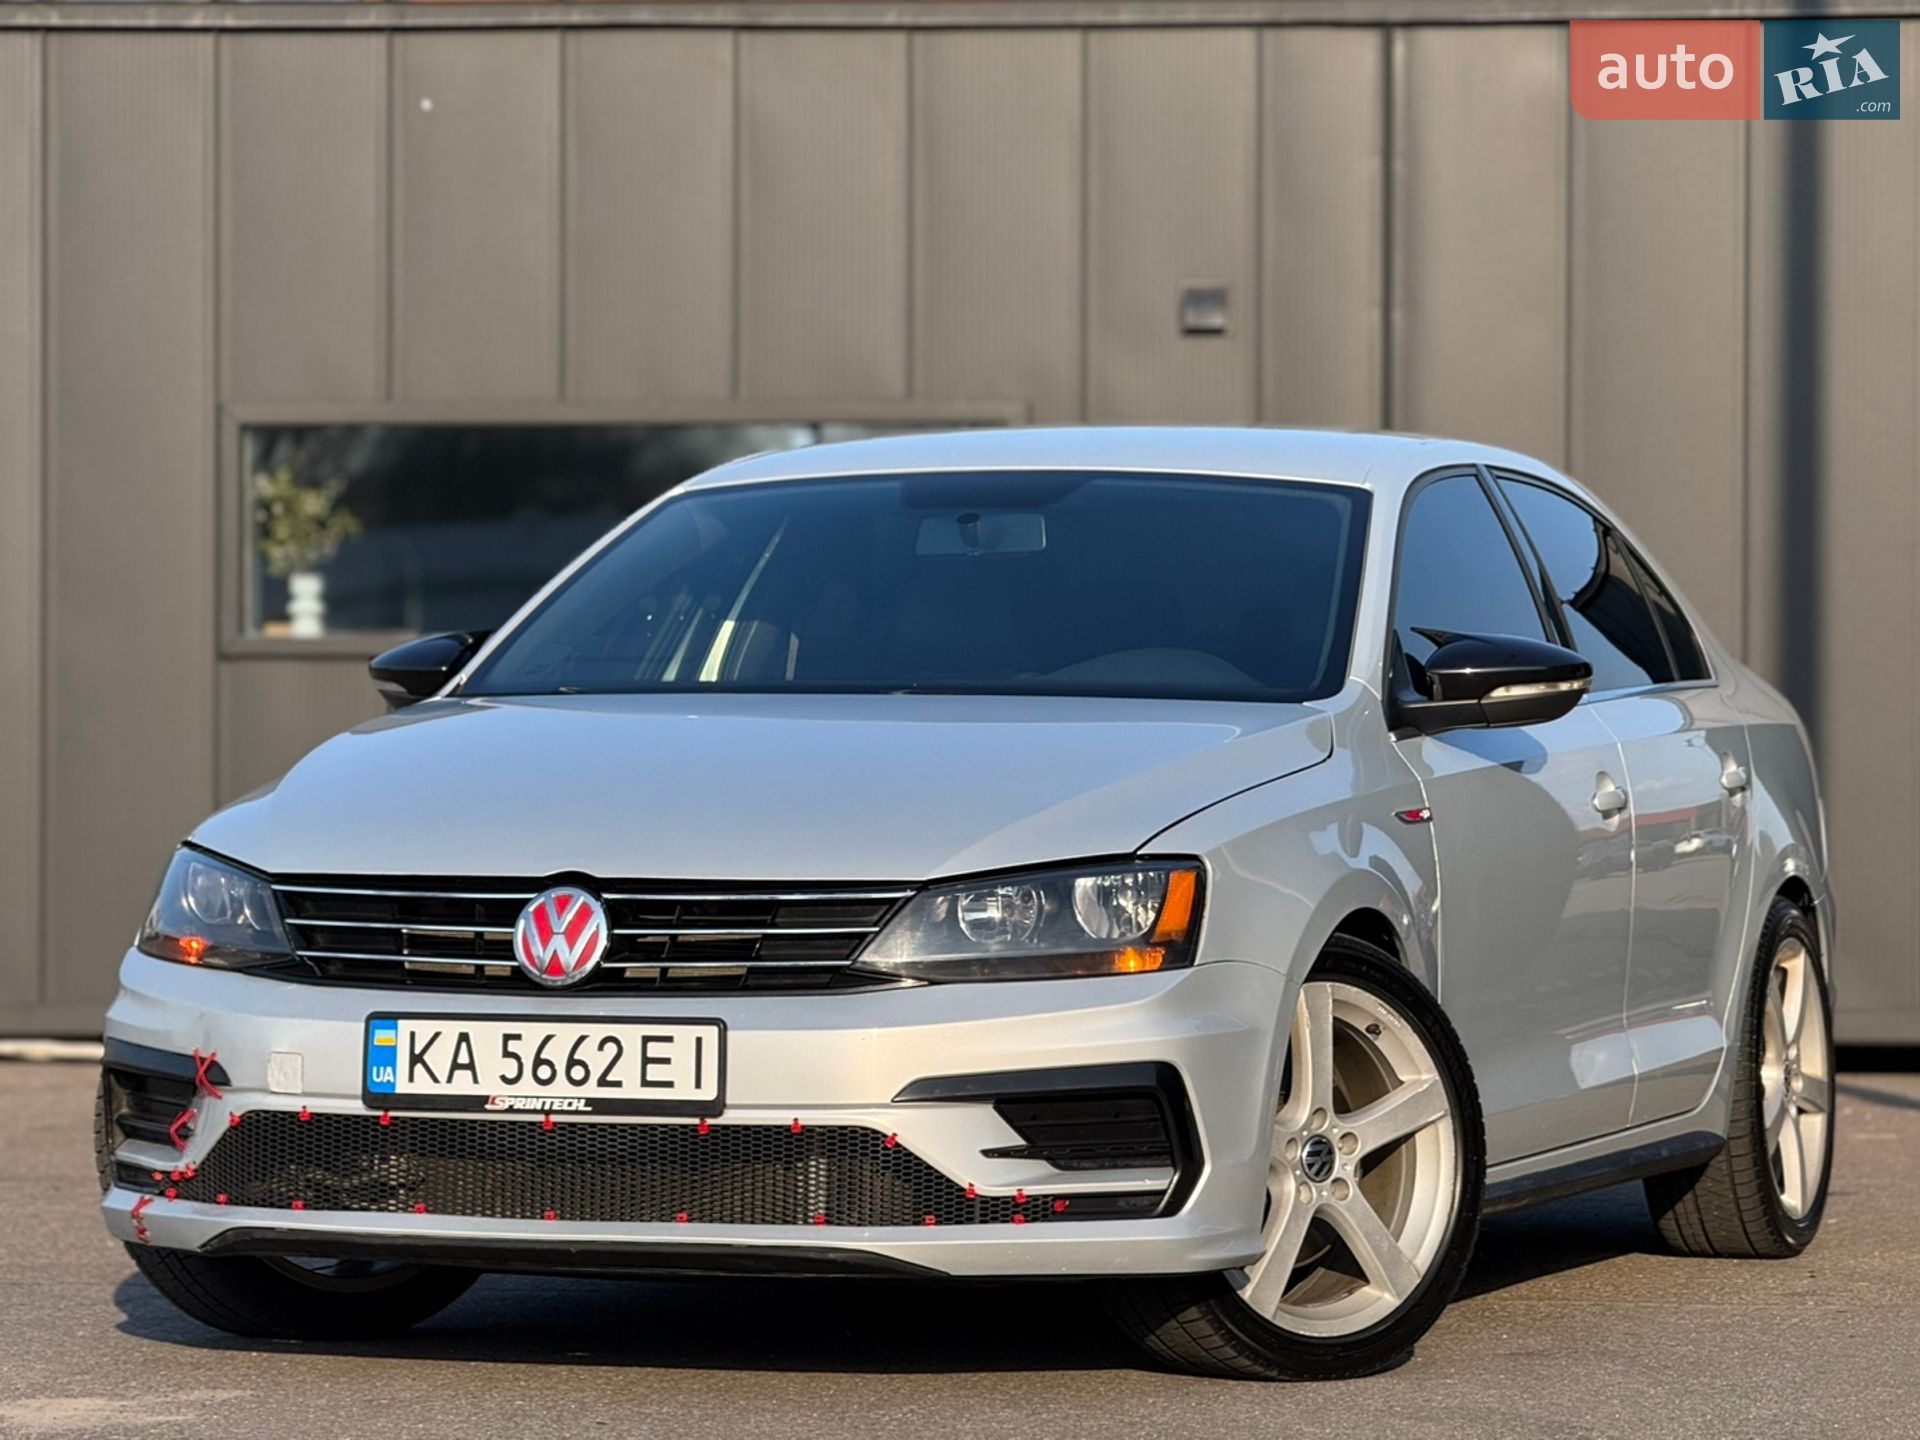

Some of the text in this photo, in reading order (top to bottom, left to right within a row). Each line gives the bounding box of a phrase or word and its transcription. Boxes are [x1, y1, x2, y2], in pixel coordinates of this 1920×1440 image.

[372, 1065, 396, 1084] UA
[407, 1030, 704, 1090] KA 5662 EI
